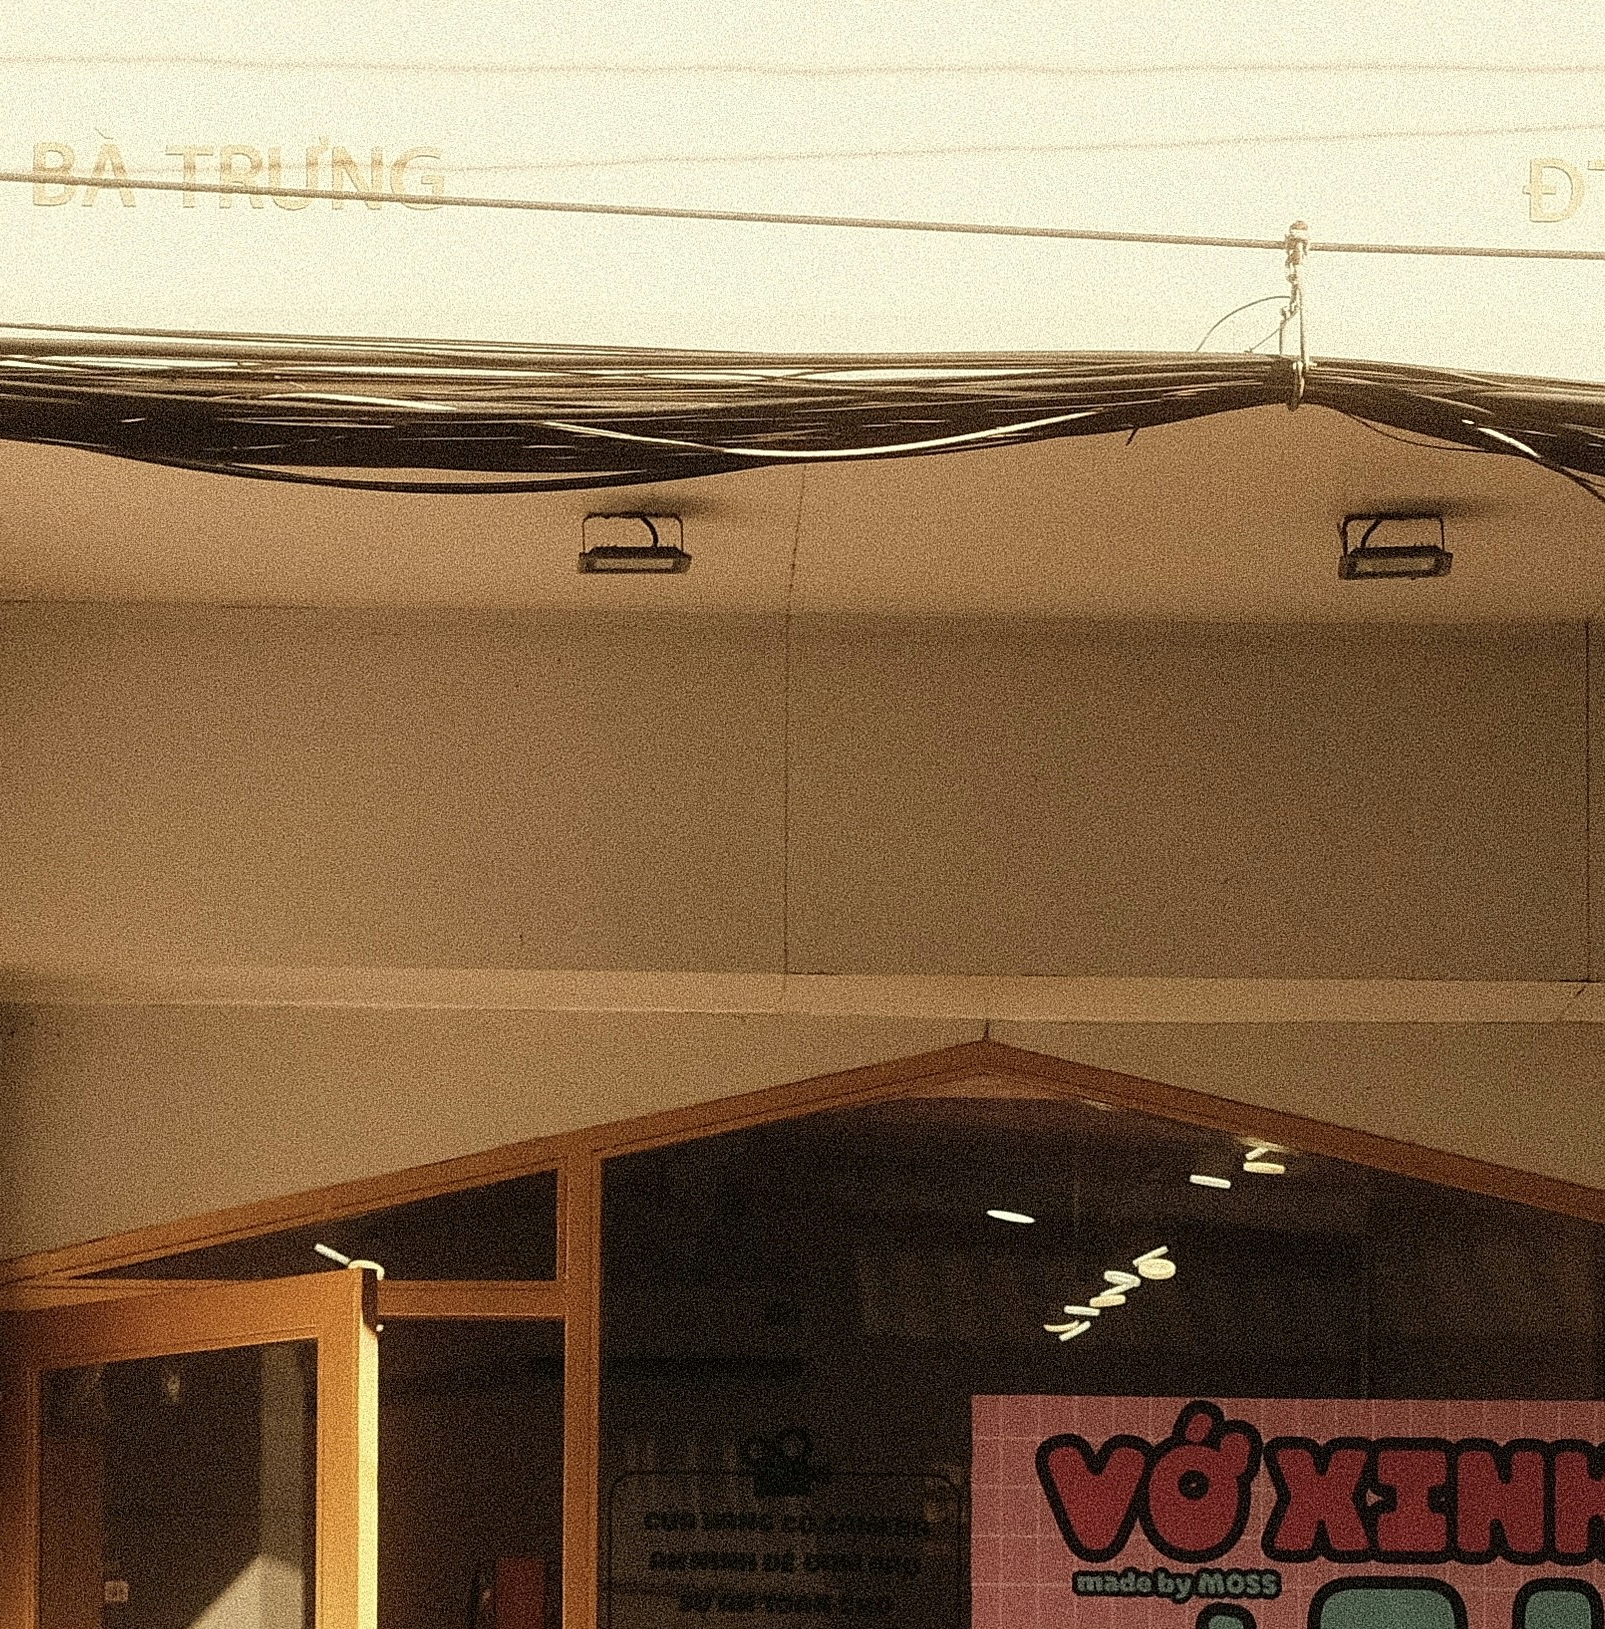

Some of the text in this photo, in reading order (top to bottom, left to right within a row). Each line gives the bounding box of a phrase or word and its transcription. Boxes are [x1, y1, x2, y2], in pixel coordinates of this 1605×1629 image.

[32, 128, 140, 210] BÀ
[1035, 1400, 1262, 1563] VỚ
[1072, 1569, 1282, 1602] made by MOSS
